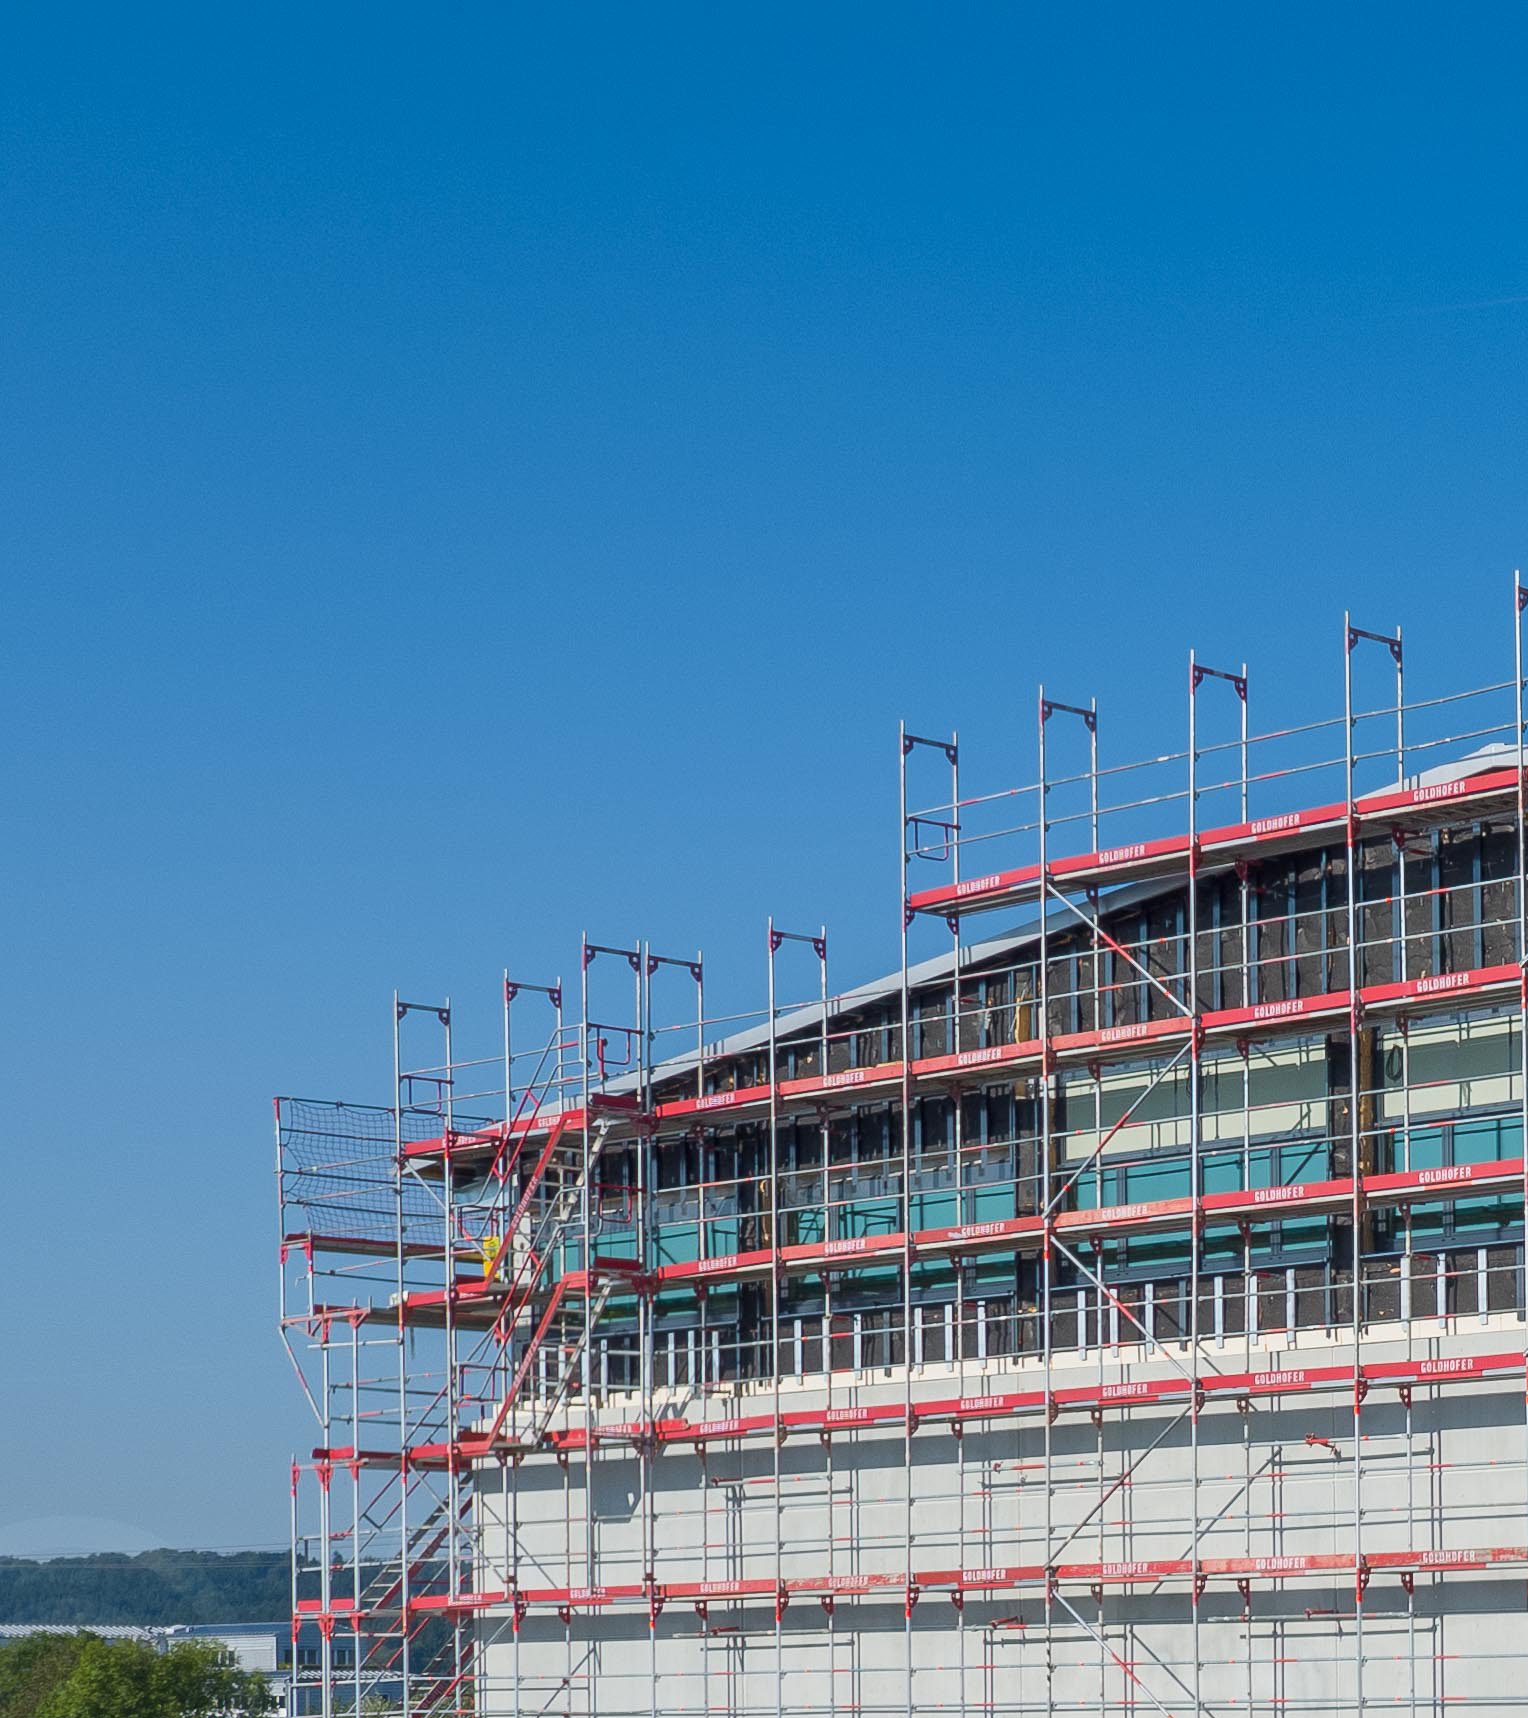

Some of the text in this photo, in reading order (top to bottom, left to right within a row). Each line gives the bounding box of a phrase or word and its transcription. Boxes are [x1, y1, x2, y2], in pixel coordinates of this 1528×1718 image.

[1413, 780, 1466, 801] GOLDHOFER
[1417, 973, 1469, 992] GOLDHOFER
[1418, 1166, 1471, 1184] GOLDHOFER
[1254, 1185, 1304, 1200] GOLDHOFER
[1421, 1359, 1473, 1373] GOLDHOFER
[1254, 1373, 1304, 1386] GOLDHOFER
[1255, 1558, 1305, 1570] GOLDHOFER
[1422, 1552, 1475, 1564] GOLDHOFER
